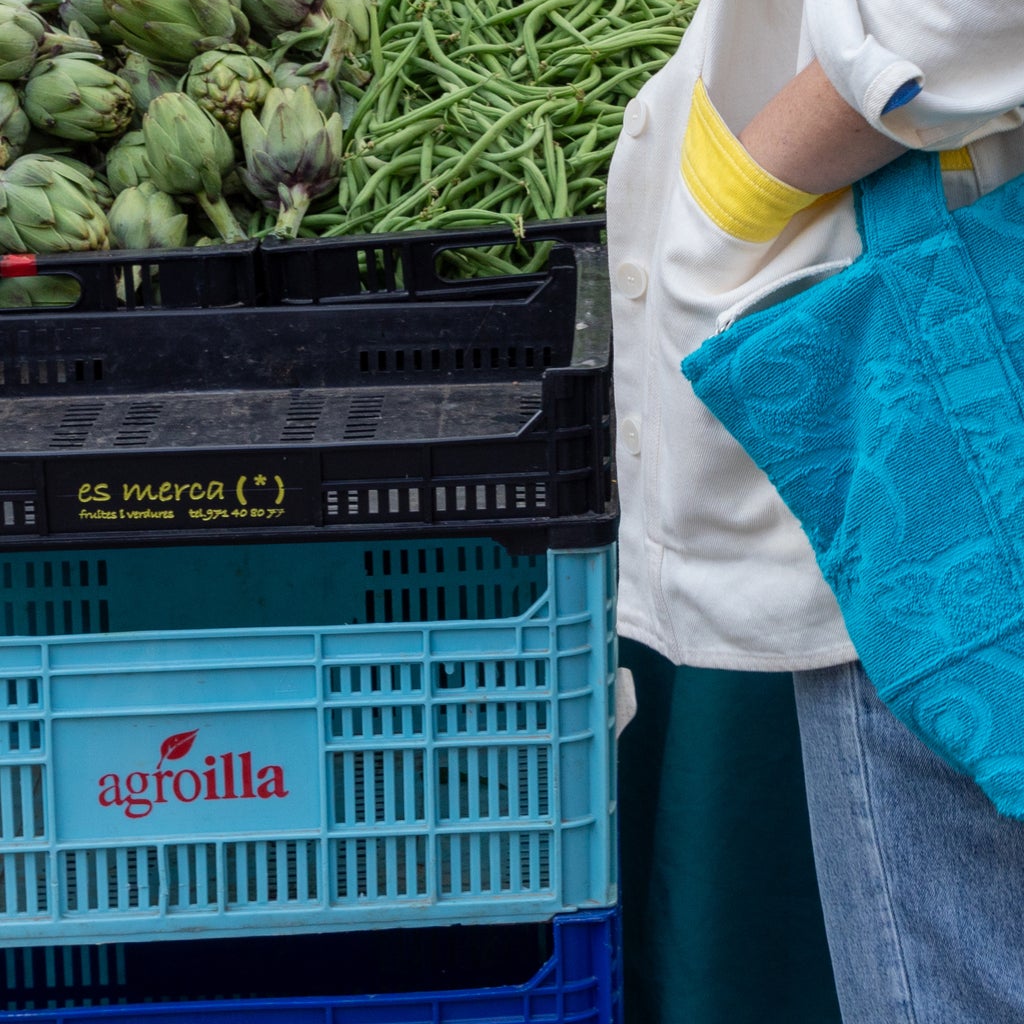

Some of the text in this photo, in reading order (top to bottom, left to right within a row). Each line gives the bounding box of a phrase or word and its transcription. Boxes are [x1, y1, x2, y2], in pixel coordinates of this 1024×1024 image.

[78, 482, 112, 503] es
[122, 480, 225, 503] merca
[98, 750, 290, 820] agroilla
